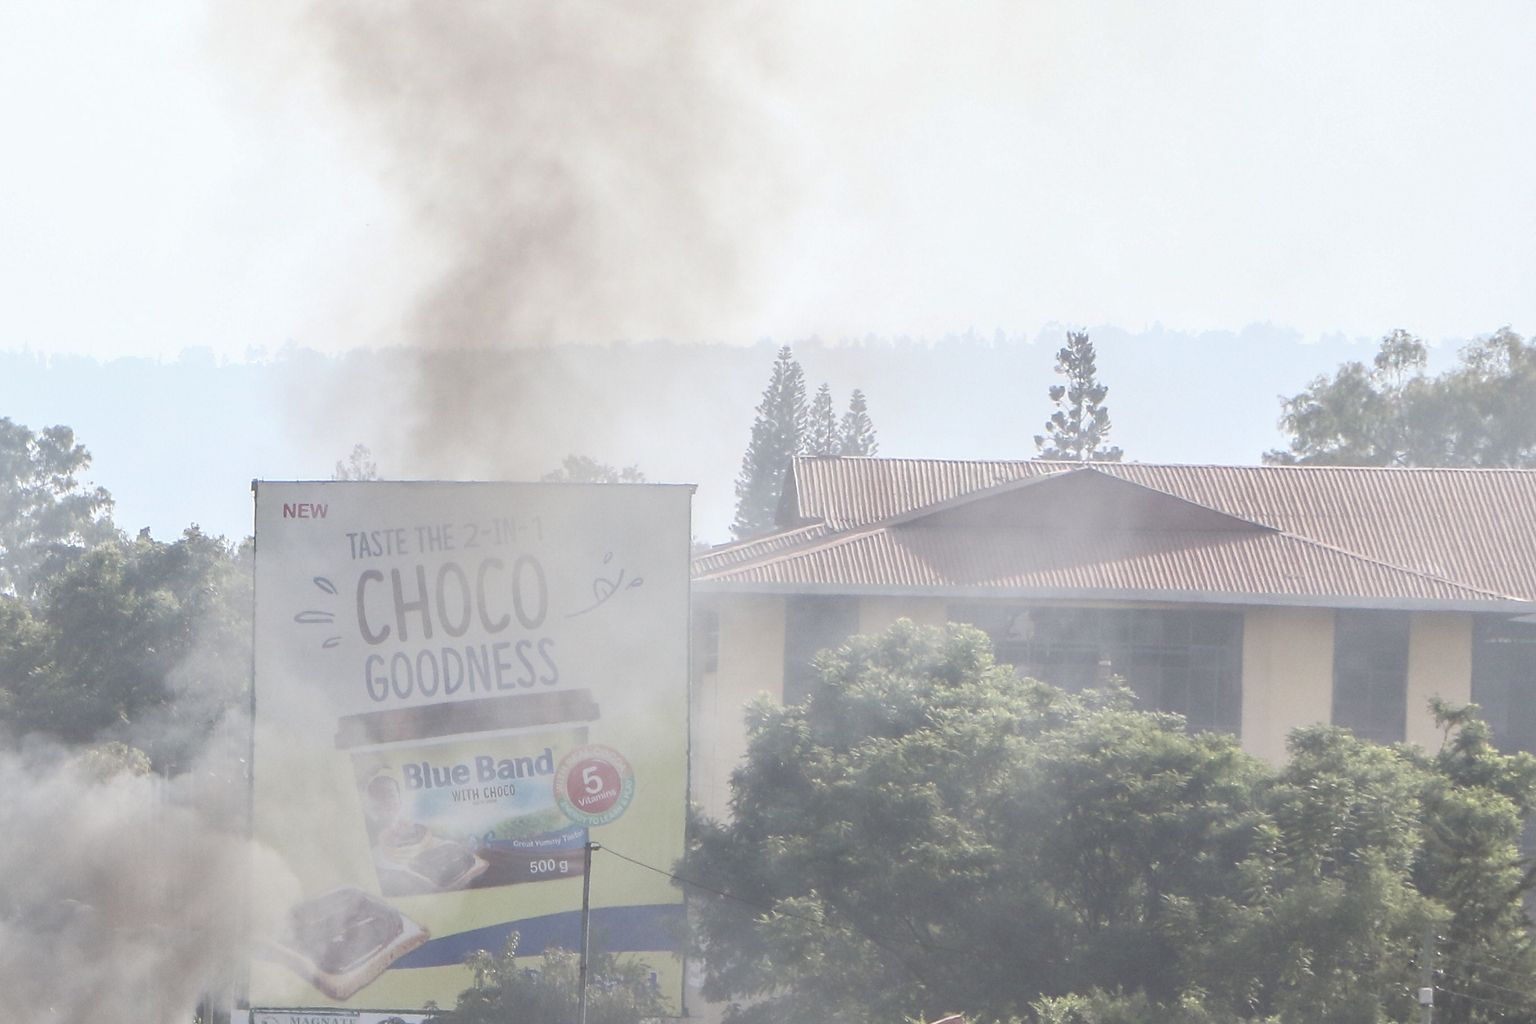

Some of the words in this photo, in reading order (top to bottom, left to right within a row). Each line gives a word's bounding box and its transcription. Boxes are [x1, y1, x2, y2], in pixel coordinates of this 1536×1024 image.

[283, 503, 328, 519] NEW
[345, 528, 408, 560] TASTE
[415, 523, 455, 554] THE
[464, 516, 543, 549] 2-IN-1
[357, 554, 548, 646] CHOCO
[365, 637, 559, 701] GOODNESS
[402, 762, 470, 791] Blue
[475, 748, 554, 783] Band
[582, 766, 603, 794] 5
[452, 789, 479, 802] WITH
[484, 784, 515, 799] CHOCO
[578, 788, 617, 806] Vitamins
[530, 860, 555, 873] 500
[559, 860, 568, 873] g
